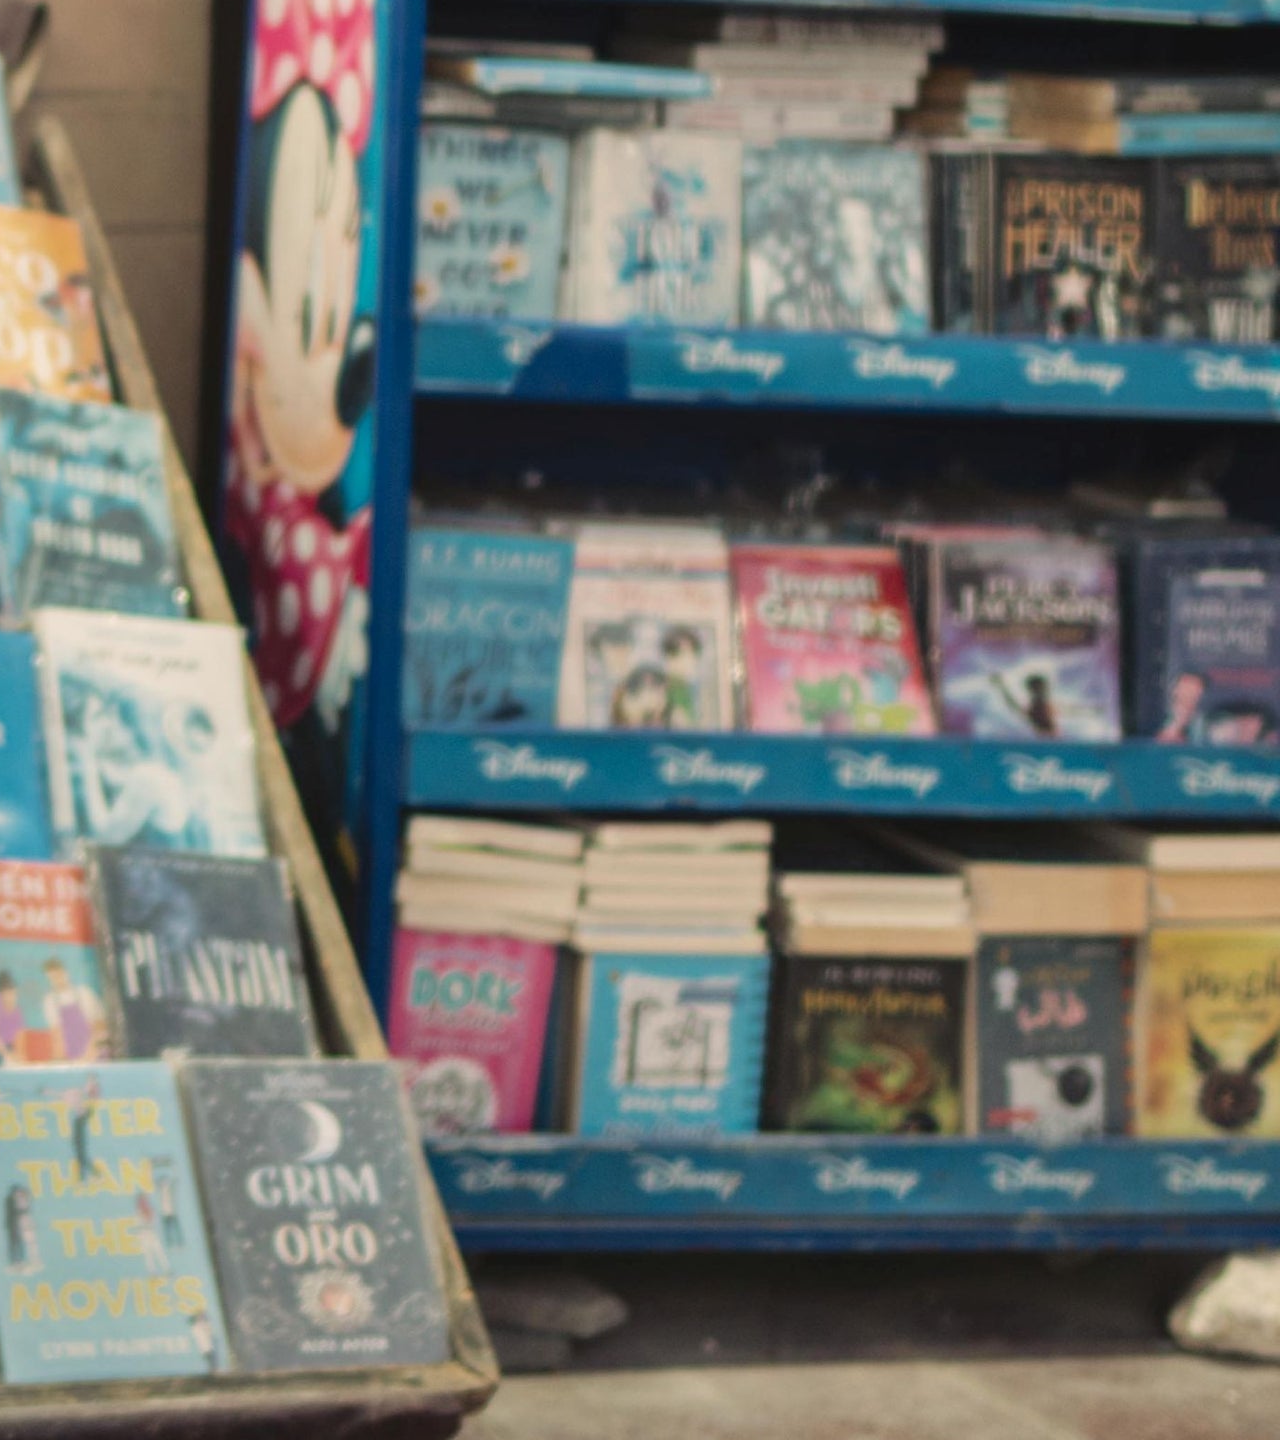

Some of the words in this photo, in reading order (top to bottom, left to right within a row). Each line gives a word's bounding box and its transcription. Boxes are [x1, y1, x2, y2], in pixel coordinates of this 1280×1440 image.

[674, 331, 785, 382] Disney
[848, 338, 958, 390] Disney
[1015, 342, 1126, 394] Disney
[475, 739, 589, 791] Disney
[650, 744, 767, 793] Disney
[826, 747, 940, 799] Disney
[1000, 751, 1111, 803] Disney
[407, 965, 524, 1016] DORK
[16, 1156, 157, 1199] THAN
[246, 1163, 383, 1209] GRIM
[451, 1154, 567, 1200] Disney
[631, 1154, 744, 1203] Disney
[809, 1152, 920, 1200] Disney
[982, 1151, 1096, 1200] Disney
[1158, 1152, 1269, 1202] Disney
[52, 1216, 143, 1261] THE
[274, 1222, 378, 1268] ORO
[7, 1272, 209, 1324] MOVIES
